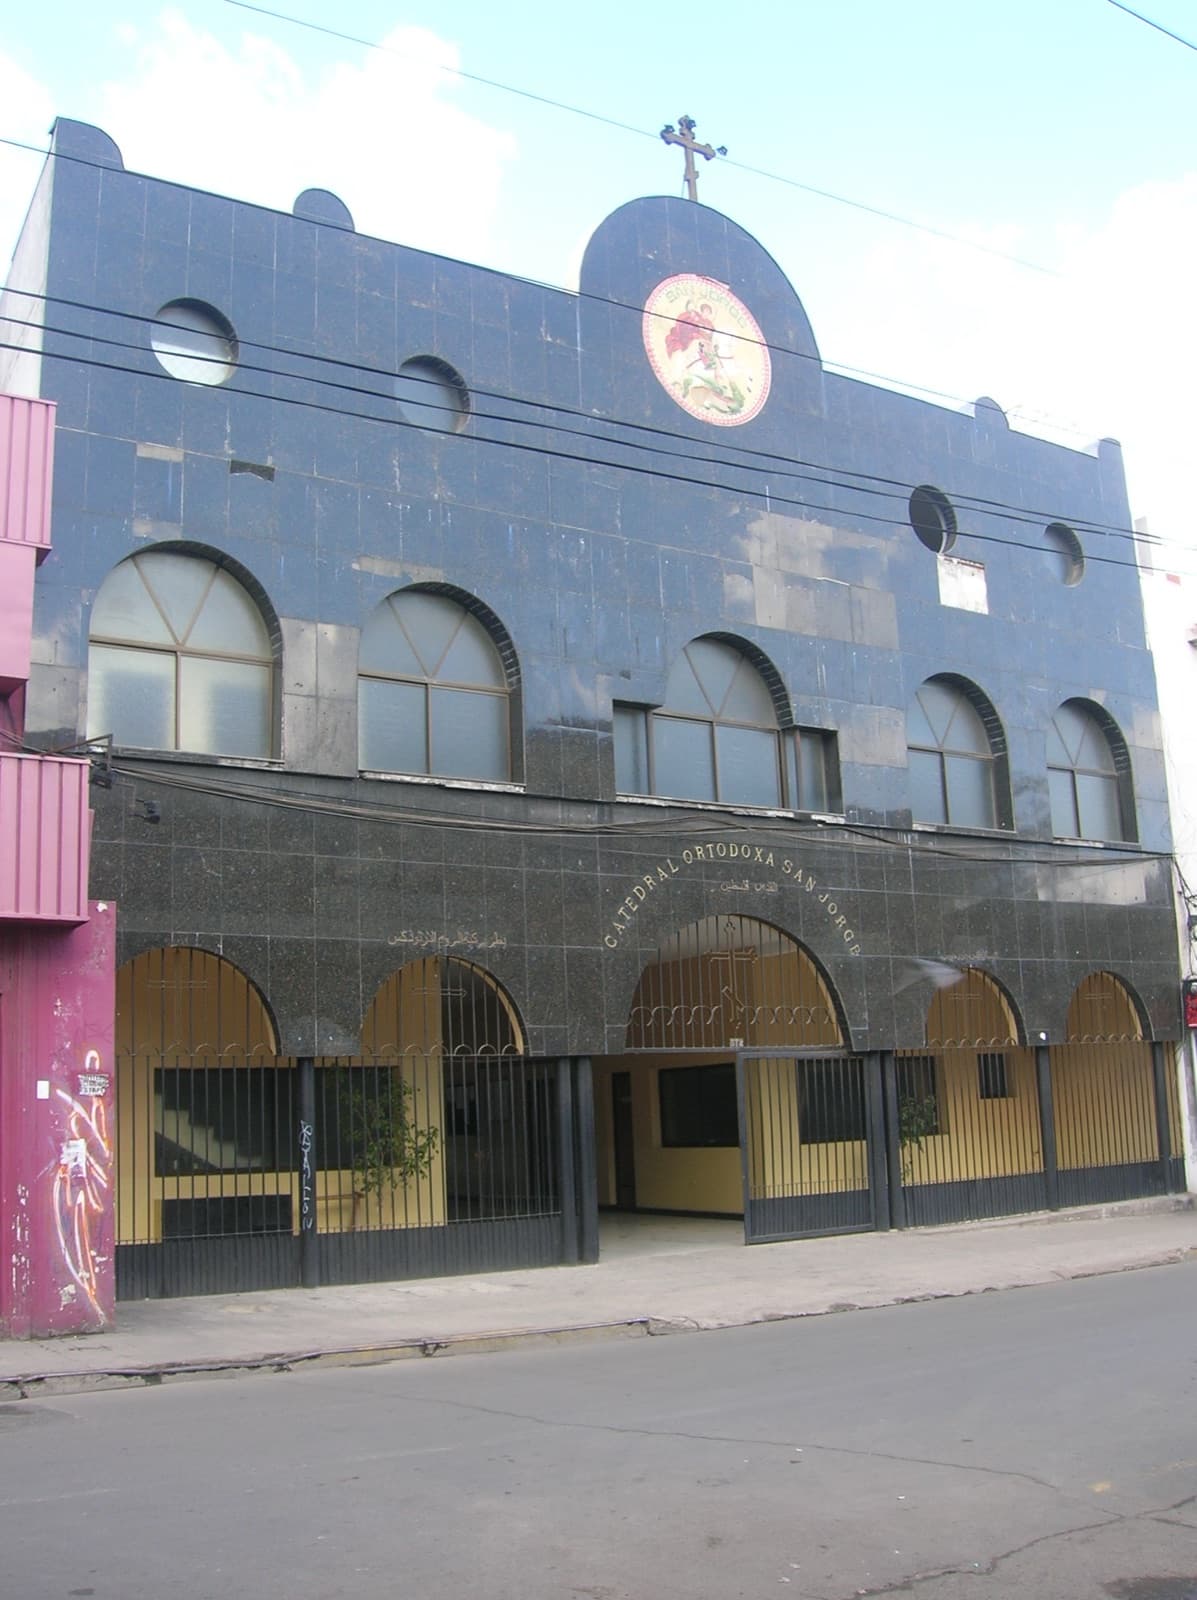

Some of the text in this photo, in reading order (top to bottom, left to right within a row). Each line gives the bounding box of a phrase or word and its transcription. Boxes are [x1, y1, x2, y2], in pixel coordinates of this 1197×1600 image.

[604, 843, 862, 957] CATEDRAL ORTODOXA SAN JORGE
